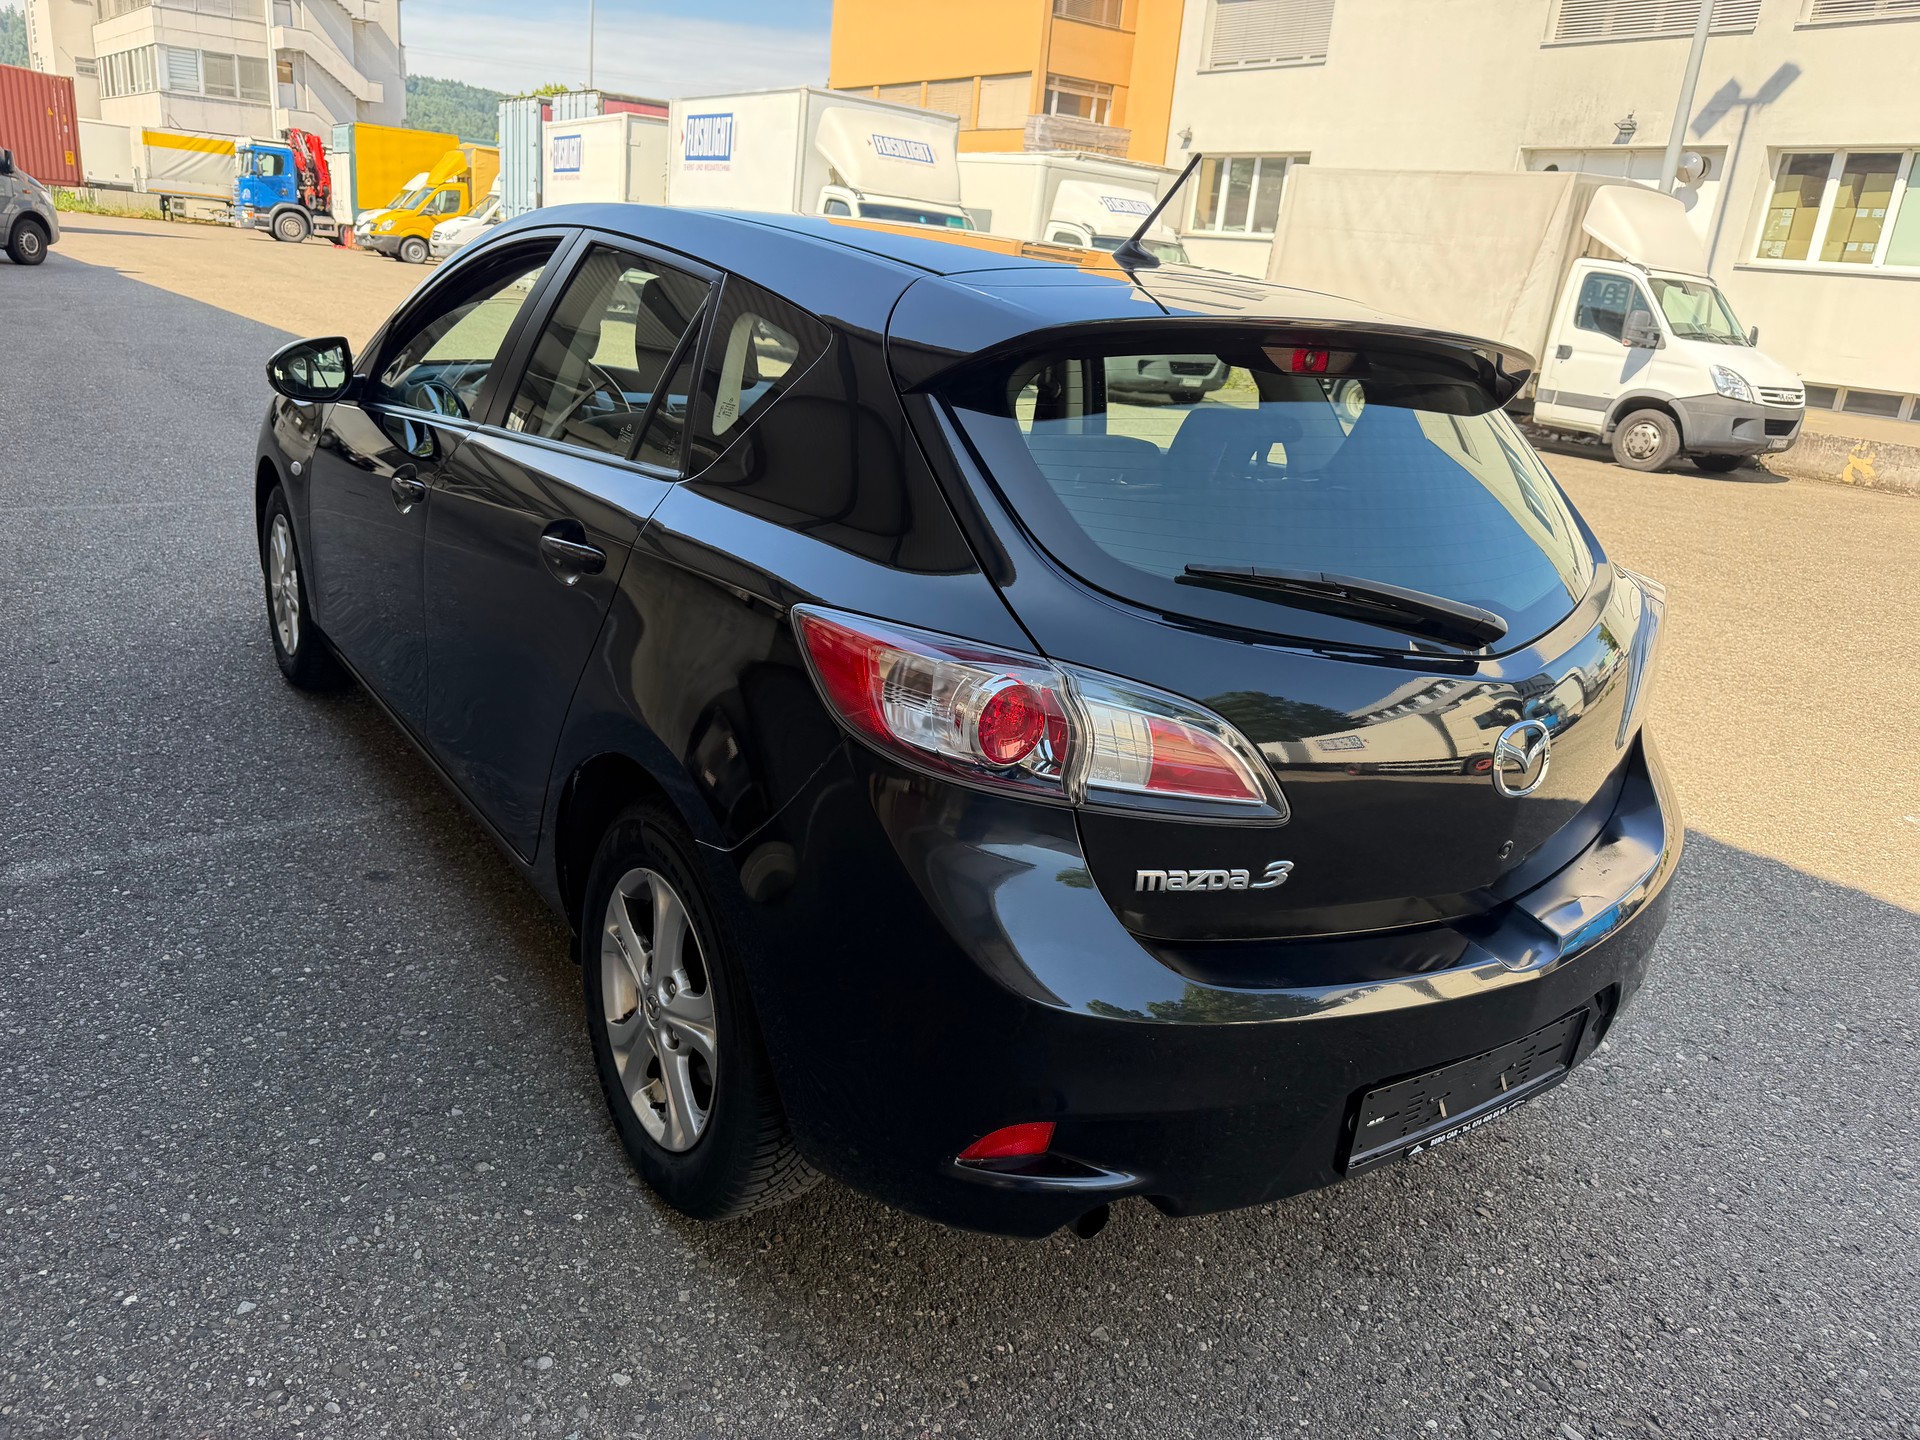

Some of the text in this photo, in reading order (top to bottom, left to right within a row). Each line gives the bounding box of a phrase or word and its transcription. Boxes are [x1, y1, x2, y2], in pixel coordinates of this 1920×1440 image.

[685, 115, 732, 158] FLASHLIGHT
[873, 134, 933, 162] FLASHLIGHT
[1250, 860, 1294, 888] 3
